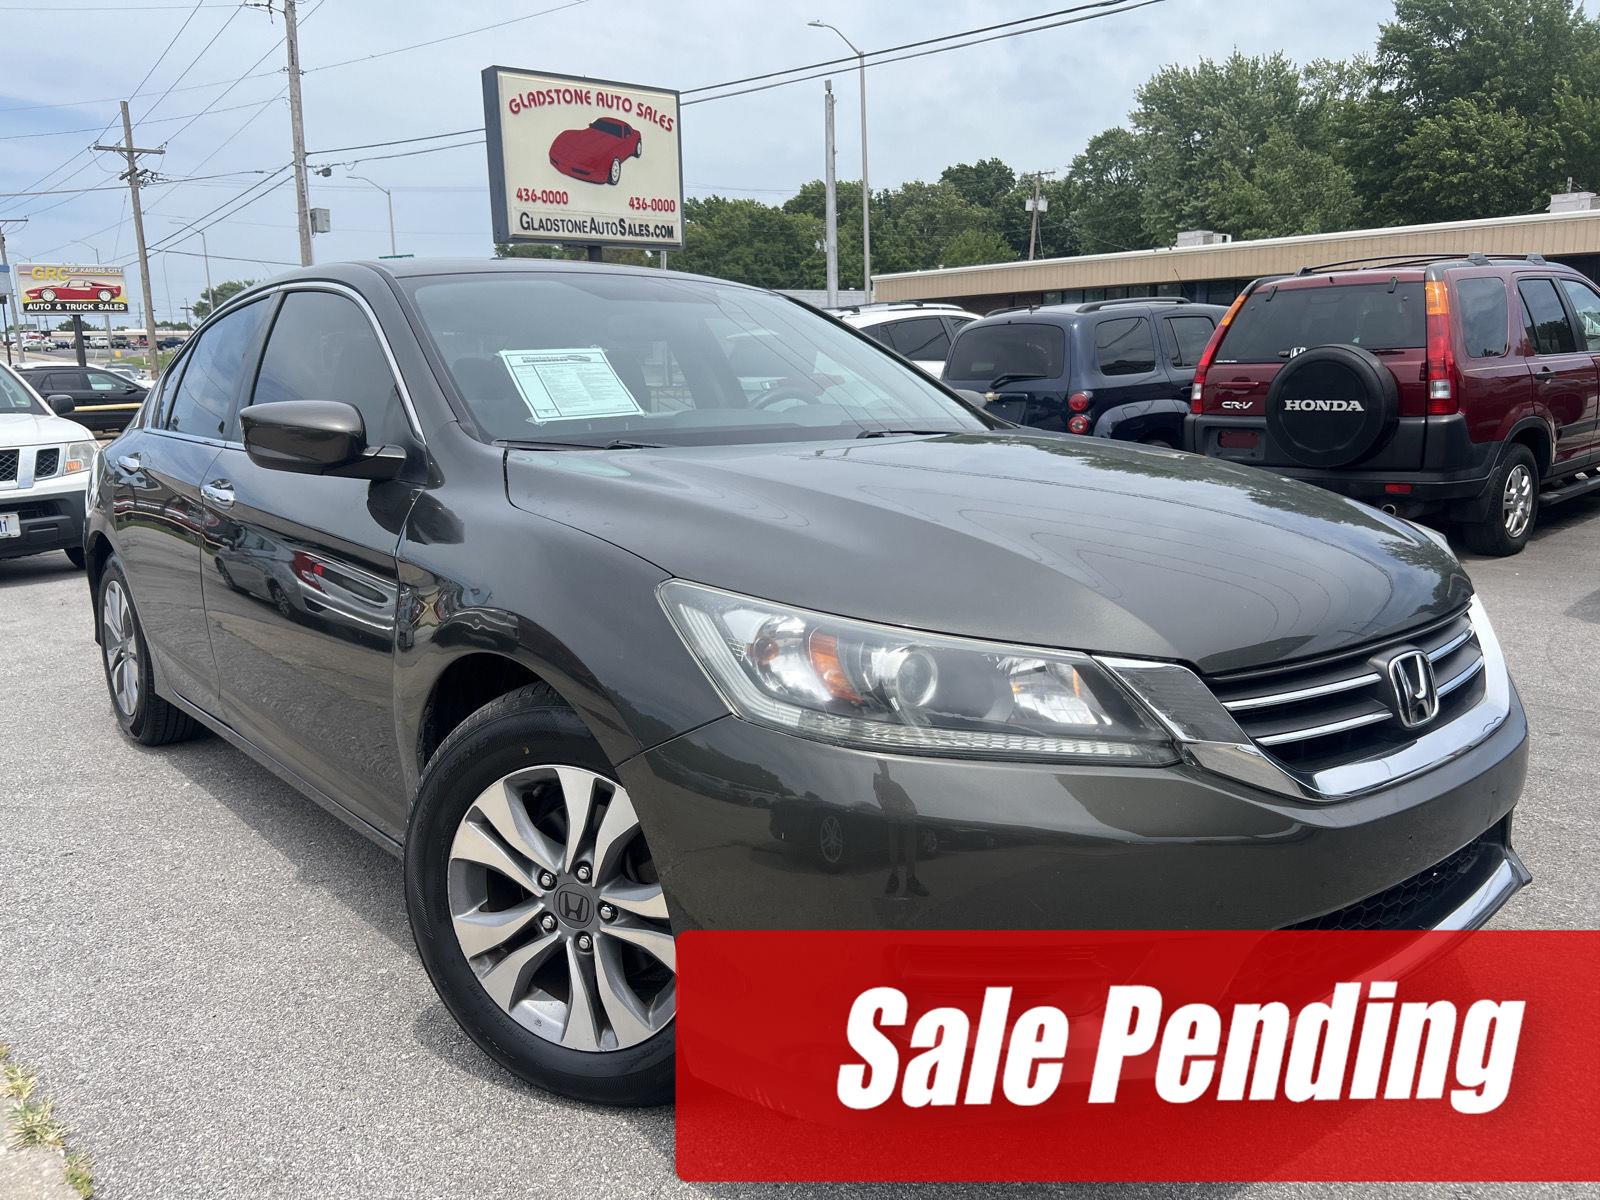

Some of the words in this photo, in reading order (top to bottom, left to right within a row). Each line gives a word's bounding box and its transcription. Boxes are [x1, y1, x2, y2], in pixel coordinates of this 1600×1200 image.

[509, 88, 592, 115] GLADSTONE
[596, 92, 632, 113] AUTO
[636, 102, 674, 132] SALES
[516, 187, 569, 205] 436-0000
[629, 197, 676, 212] 436-0000
[31, 266, 70, 281] GRC
[1221, 401, 1253, 410] CR-V
[1284, 400, 1365, 412] HONDA
